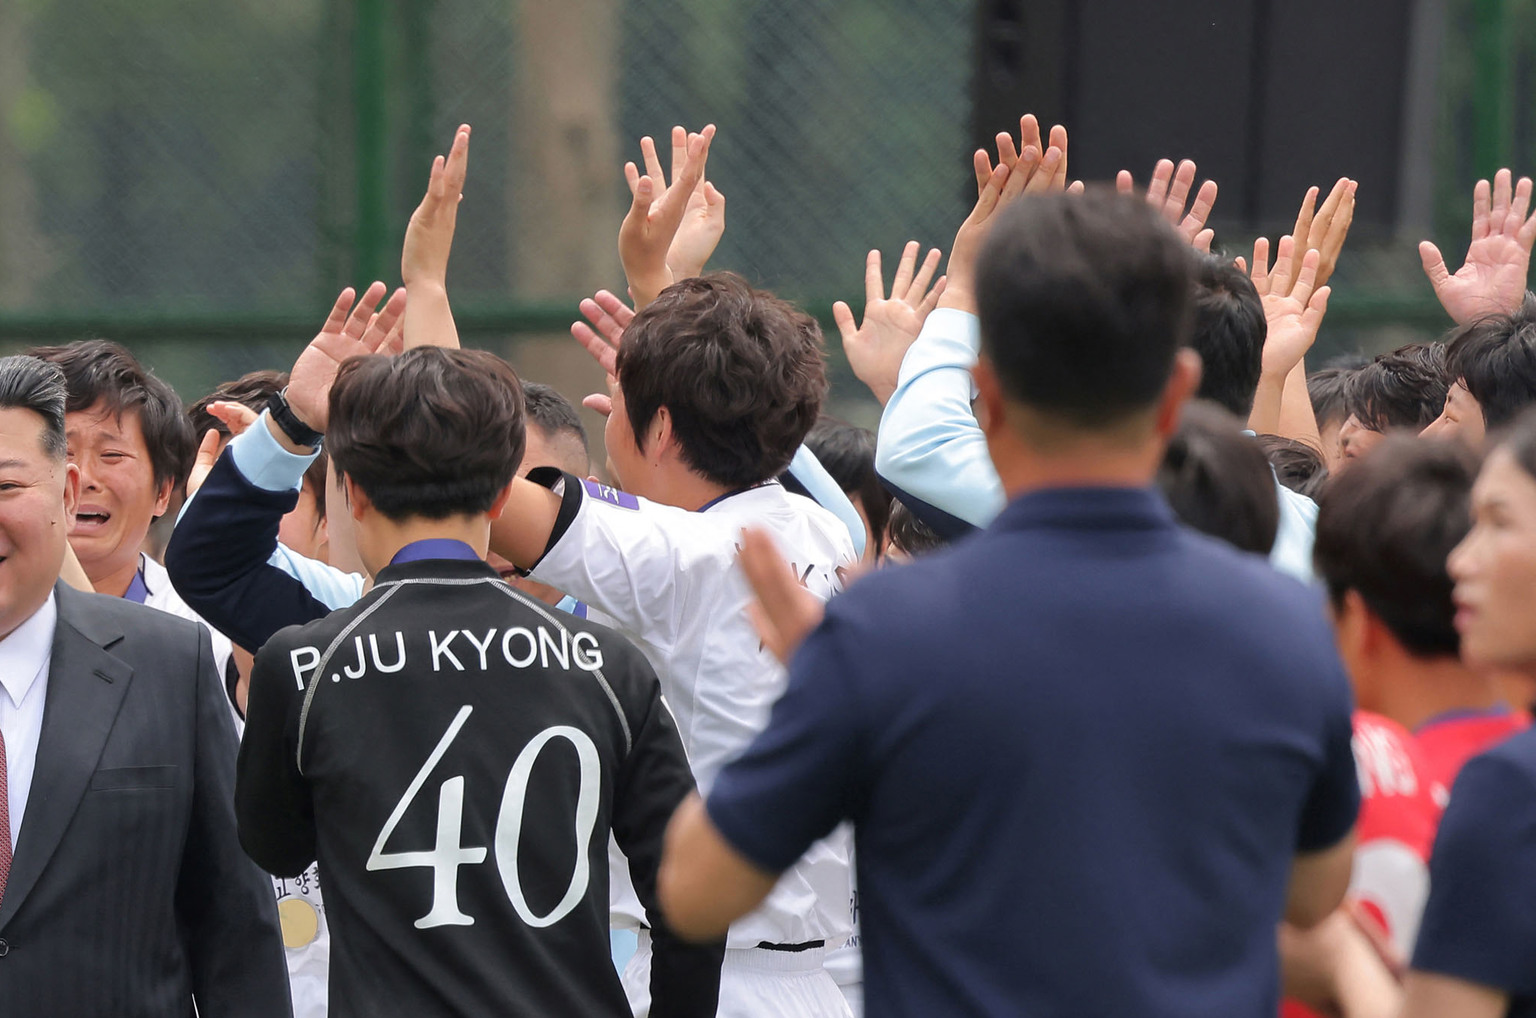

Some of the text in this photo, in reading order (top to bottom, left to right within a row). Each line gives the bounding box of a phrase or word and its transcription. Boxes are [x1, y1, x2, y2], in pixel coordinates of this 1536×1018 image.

[289, 626, 605, 691] P.JU KYONG
[365, 704, 602, 930] 40
